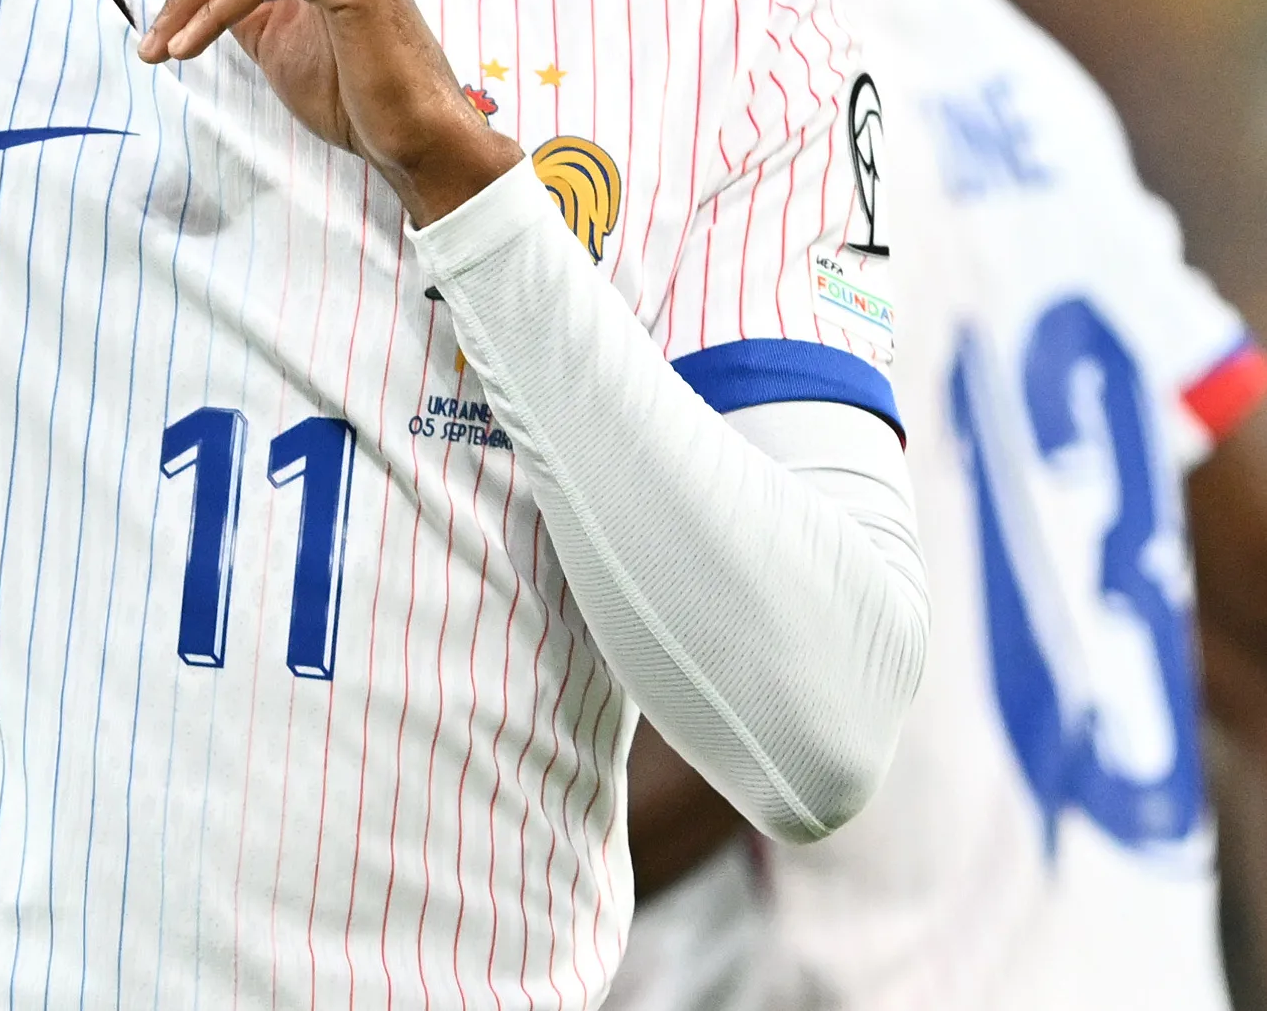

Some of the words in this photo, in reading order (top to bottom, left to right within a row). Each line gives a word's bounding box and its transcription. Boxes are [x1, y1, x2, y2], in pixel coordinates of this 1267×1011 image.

[817, 275, 894, 325] FOUNDA
[408, 415, 435, 437] 05
[440, 421, 514, 451] SEPTEMBR
[160, 406, 357, 681] 11
